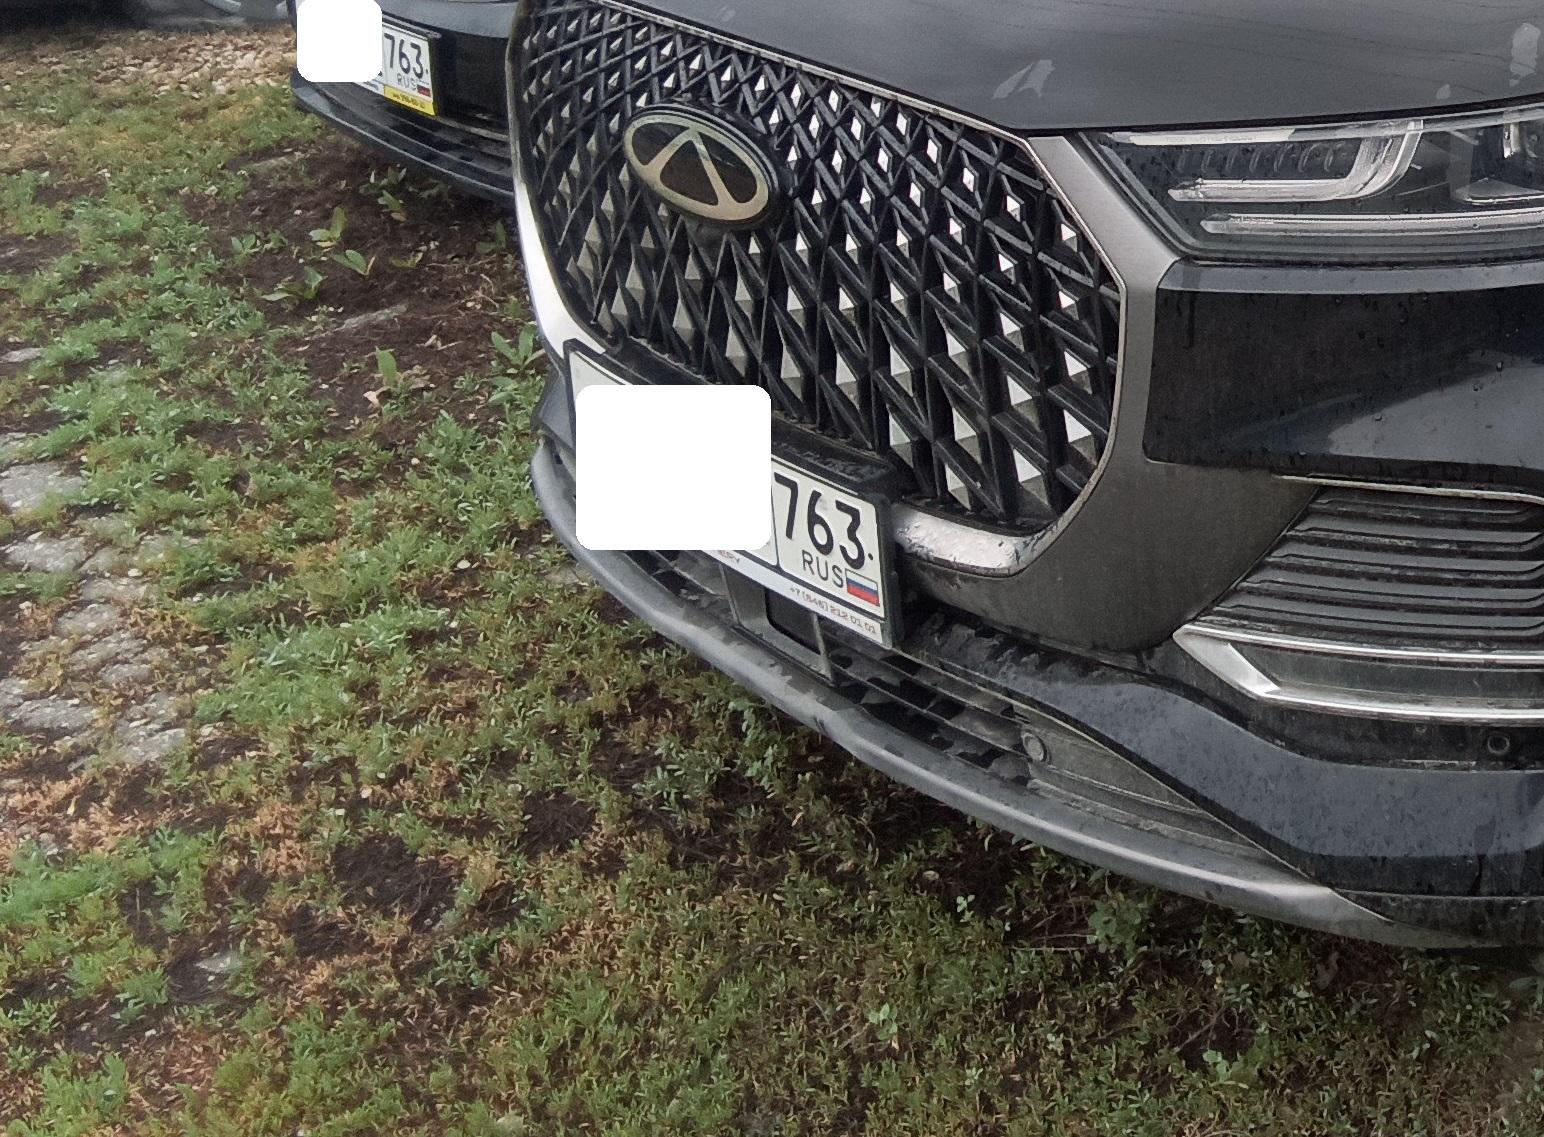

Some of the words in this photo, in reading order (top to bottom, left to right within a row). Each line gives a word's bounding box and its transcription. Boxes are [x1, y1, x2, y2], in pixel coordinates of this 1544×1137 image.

[384, 33, 423, 78] 763
[397, 73, 416, 91] RUS
[774, 472, 864, 569] 763
[802, 549, 844, 588] RUS
